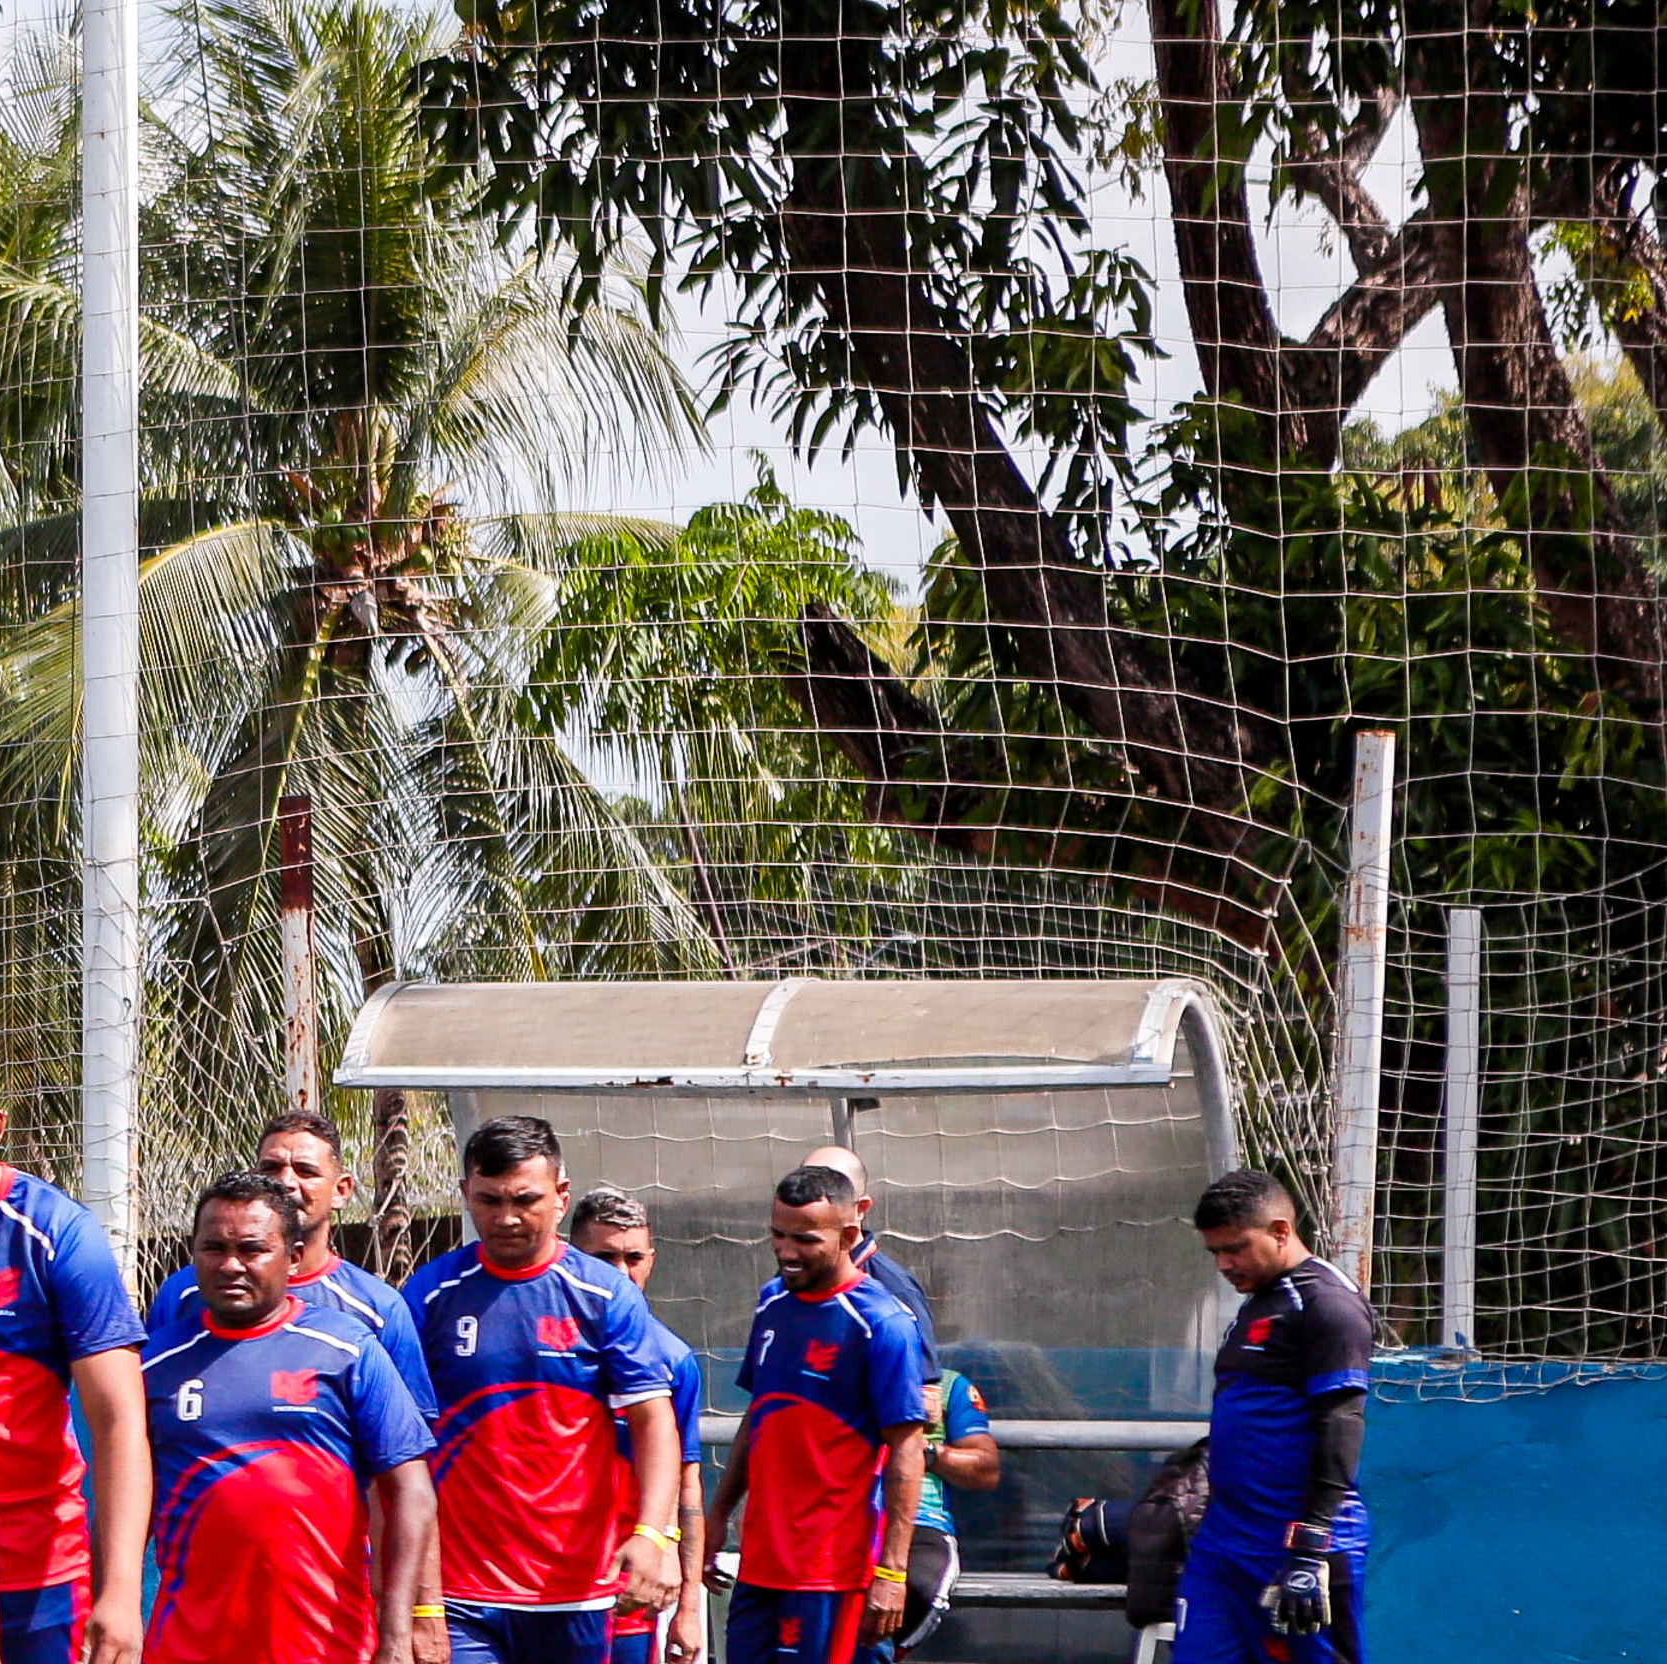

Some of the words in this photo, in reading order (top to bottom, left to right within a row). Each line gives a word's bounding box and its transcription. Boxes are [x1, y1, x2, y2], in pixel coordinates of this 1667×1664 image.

[456, 1316, 478, 1357] 9
[758, 1329, 775, 1366] 7
[177, 1379, 204, 1421] 6
